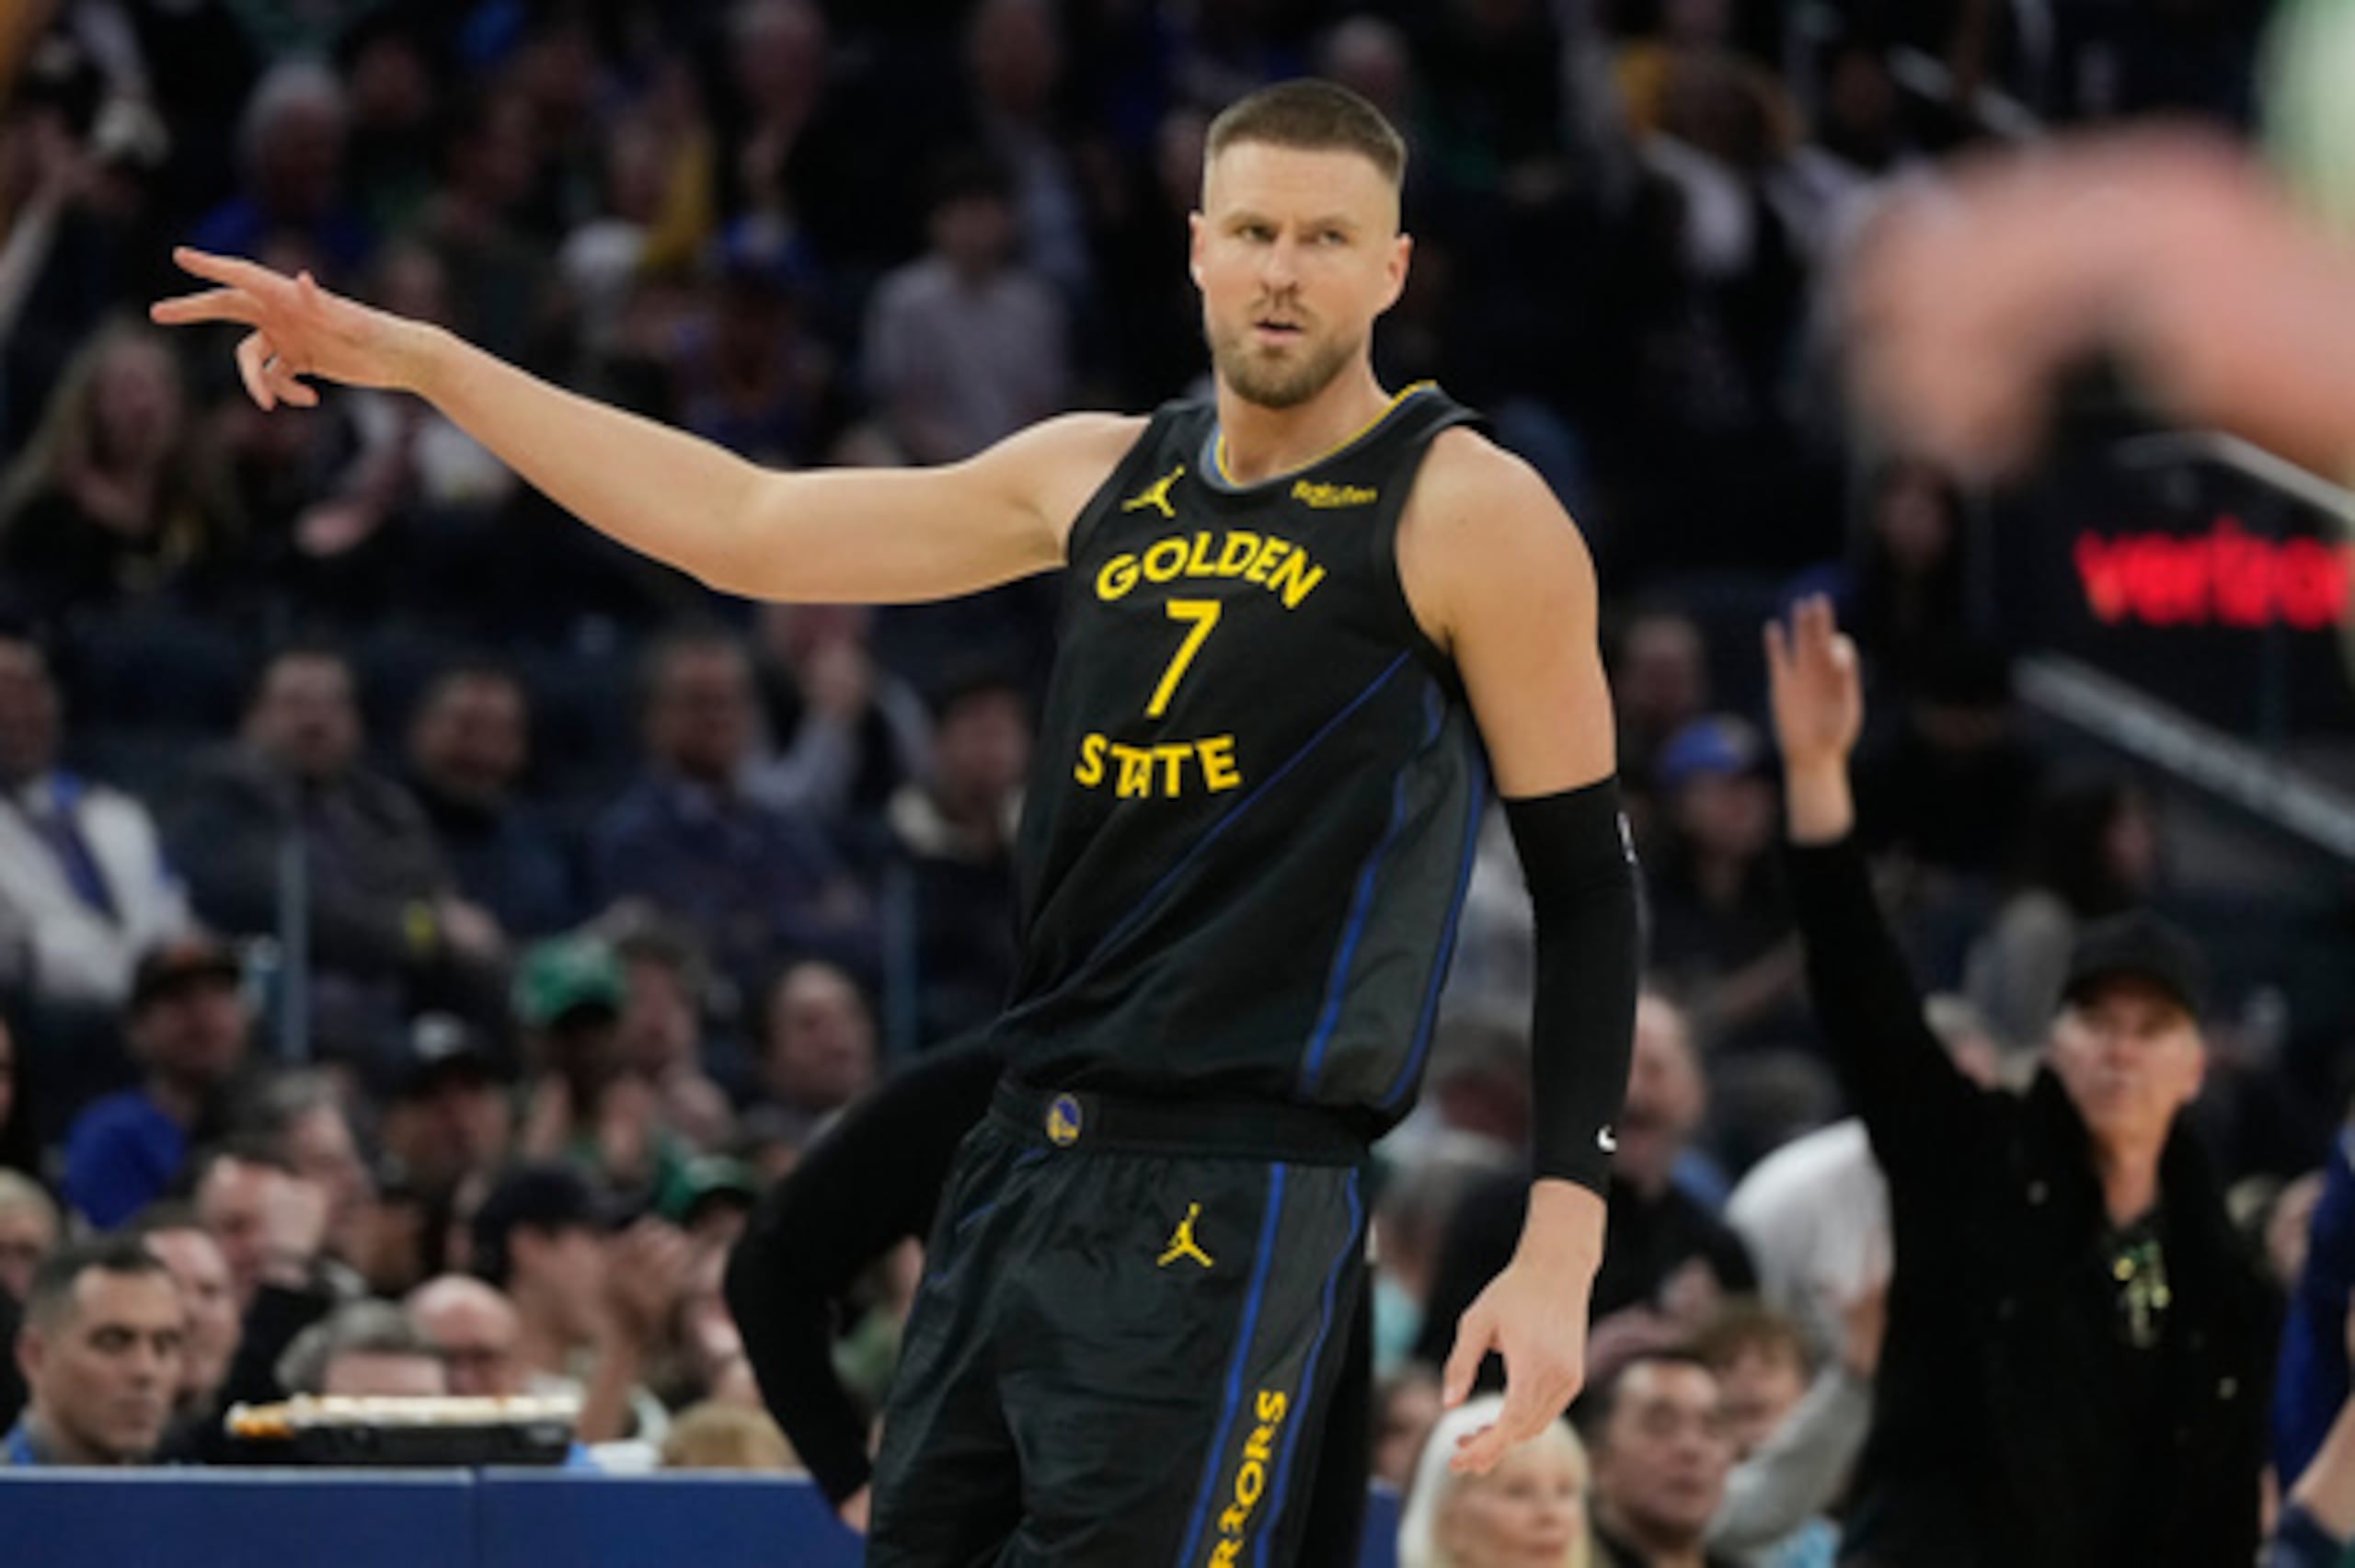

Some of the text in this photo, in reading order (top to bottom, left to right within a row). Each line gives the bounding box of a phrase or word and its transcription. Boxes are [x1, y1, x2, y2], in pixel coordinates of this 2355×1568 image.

[1095, 530, 1327, 611] GOLDEN
[1145, 597, 1223, 717] 7
[1074, 732, 1242, 799] STATE
